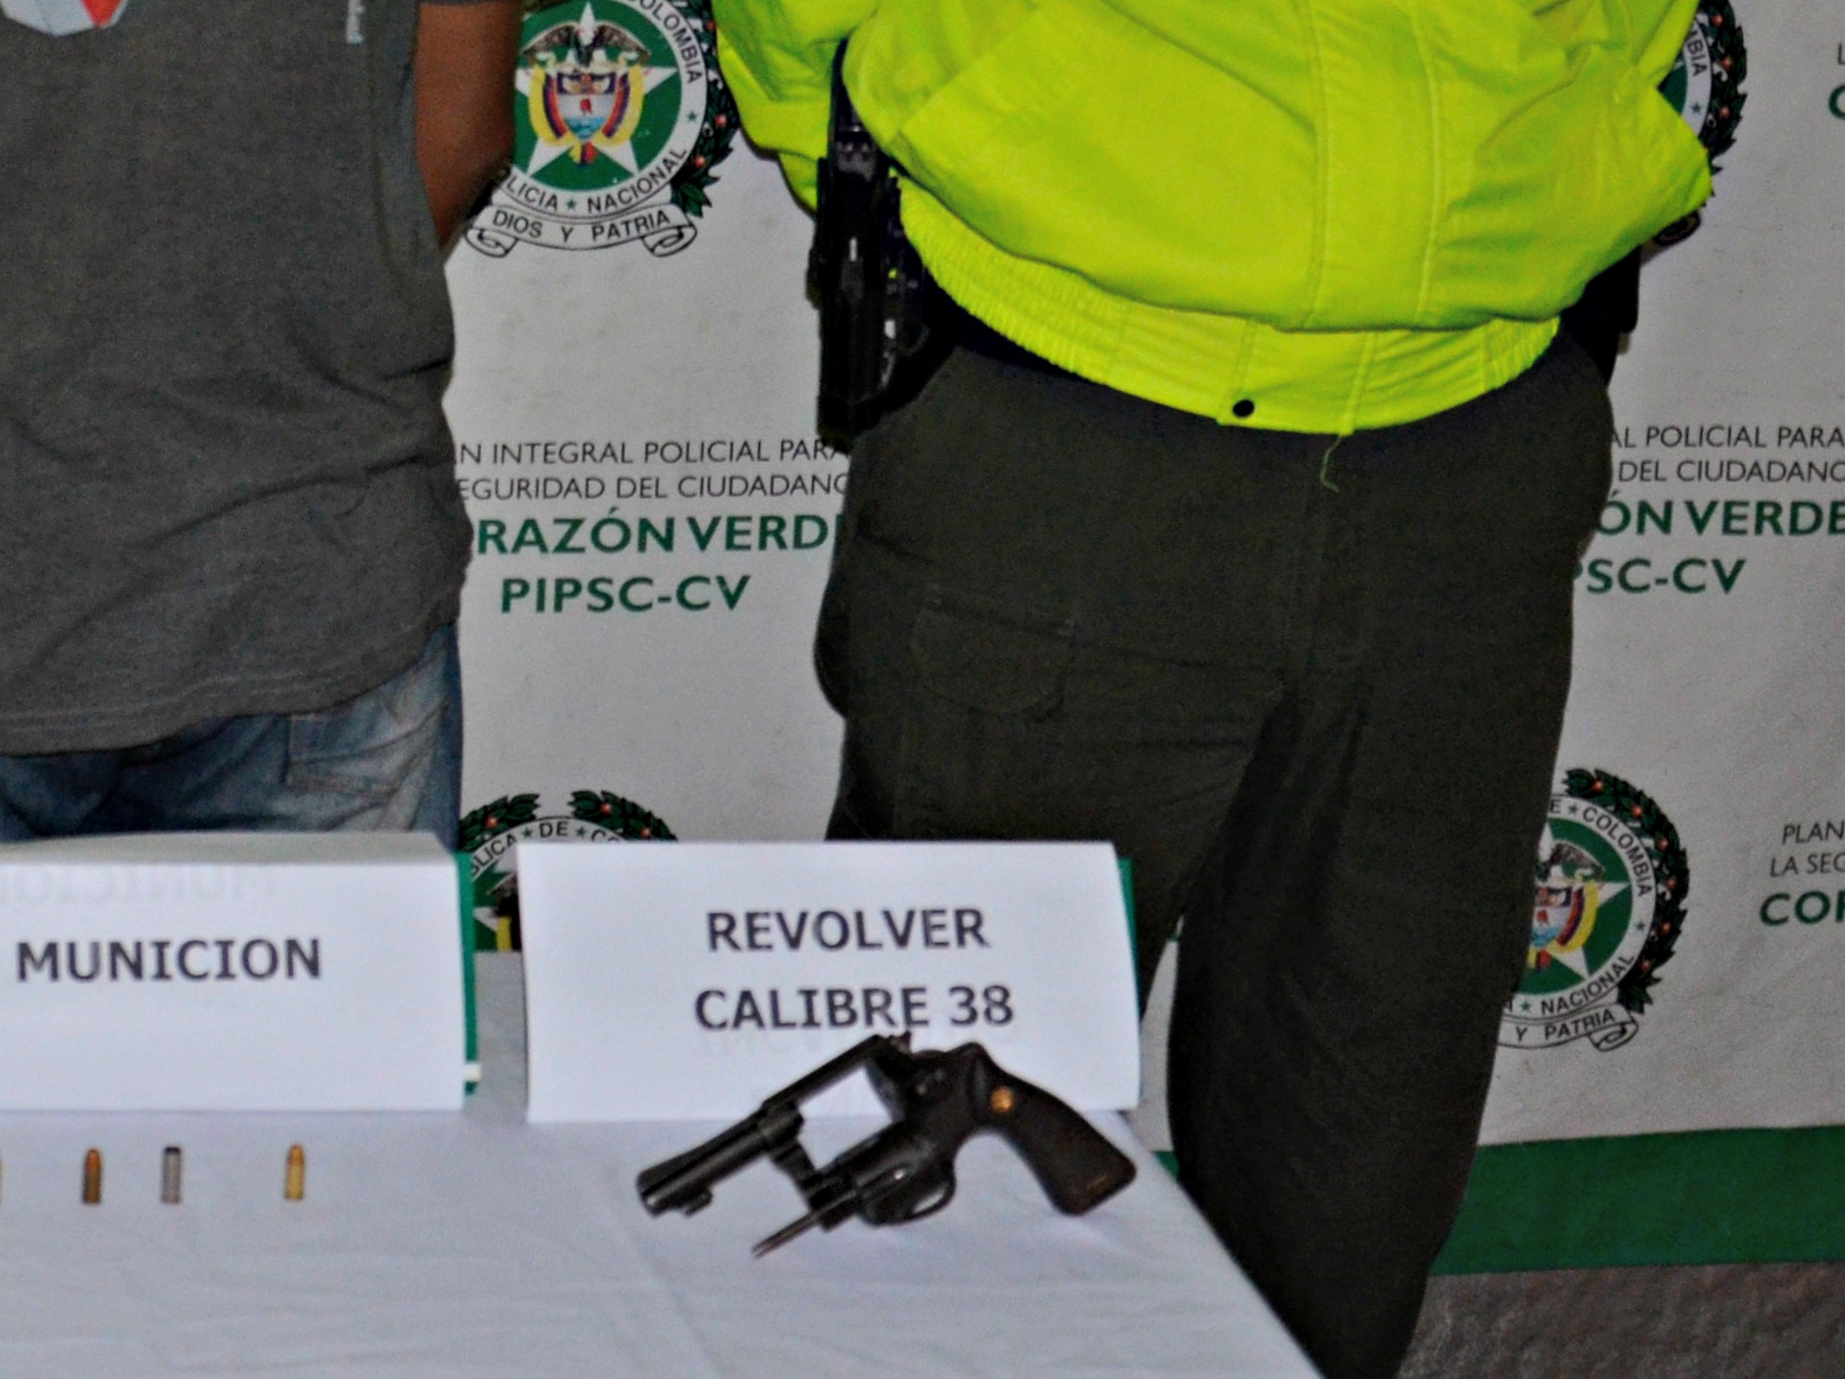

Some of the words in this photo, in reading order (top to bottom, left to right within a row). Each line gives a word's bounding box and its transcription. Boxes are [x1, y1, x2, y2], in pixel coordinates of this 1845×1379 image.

[587, 147, 687, 213] NACIONAL
[493, 211, 542, 238] DIOS
[593, 211, 670, 241] PATRIA
[1647, 426, 1767, 448] POLICIAL
[1778, 427, 1845, 448] PARA
[493, 442, 633, 464] INTEGRAL
[644, 441, 769, 464] POLICIAL
[1619, 461, 1666, 481] DEL
[617, 477, 667, 498] DEL
[502, 576, 751, 613] PIPSC-CV
[540, 821, 569, 838] DE
[1783, 820, 1845, 845] PLAN
[1582, 807, 1651, 897] COLOMBIA
[1770, 856, 1798, 877] LA
[707, 909, 991, 953] REVOLVER
[16, 938, 322, 982] MUNICION
[1540, 954, 1635, 1016] NACIONAL
[694, 986, 929, 1031] CALIBRE
[948, 985, 1014, 1026] 38
[1544, 1010, 1615, 1040] PATRIA
